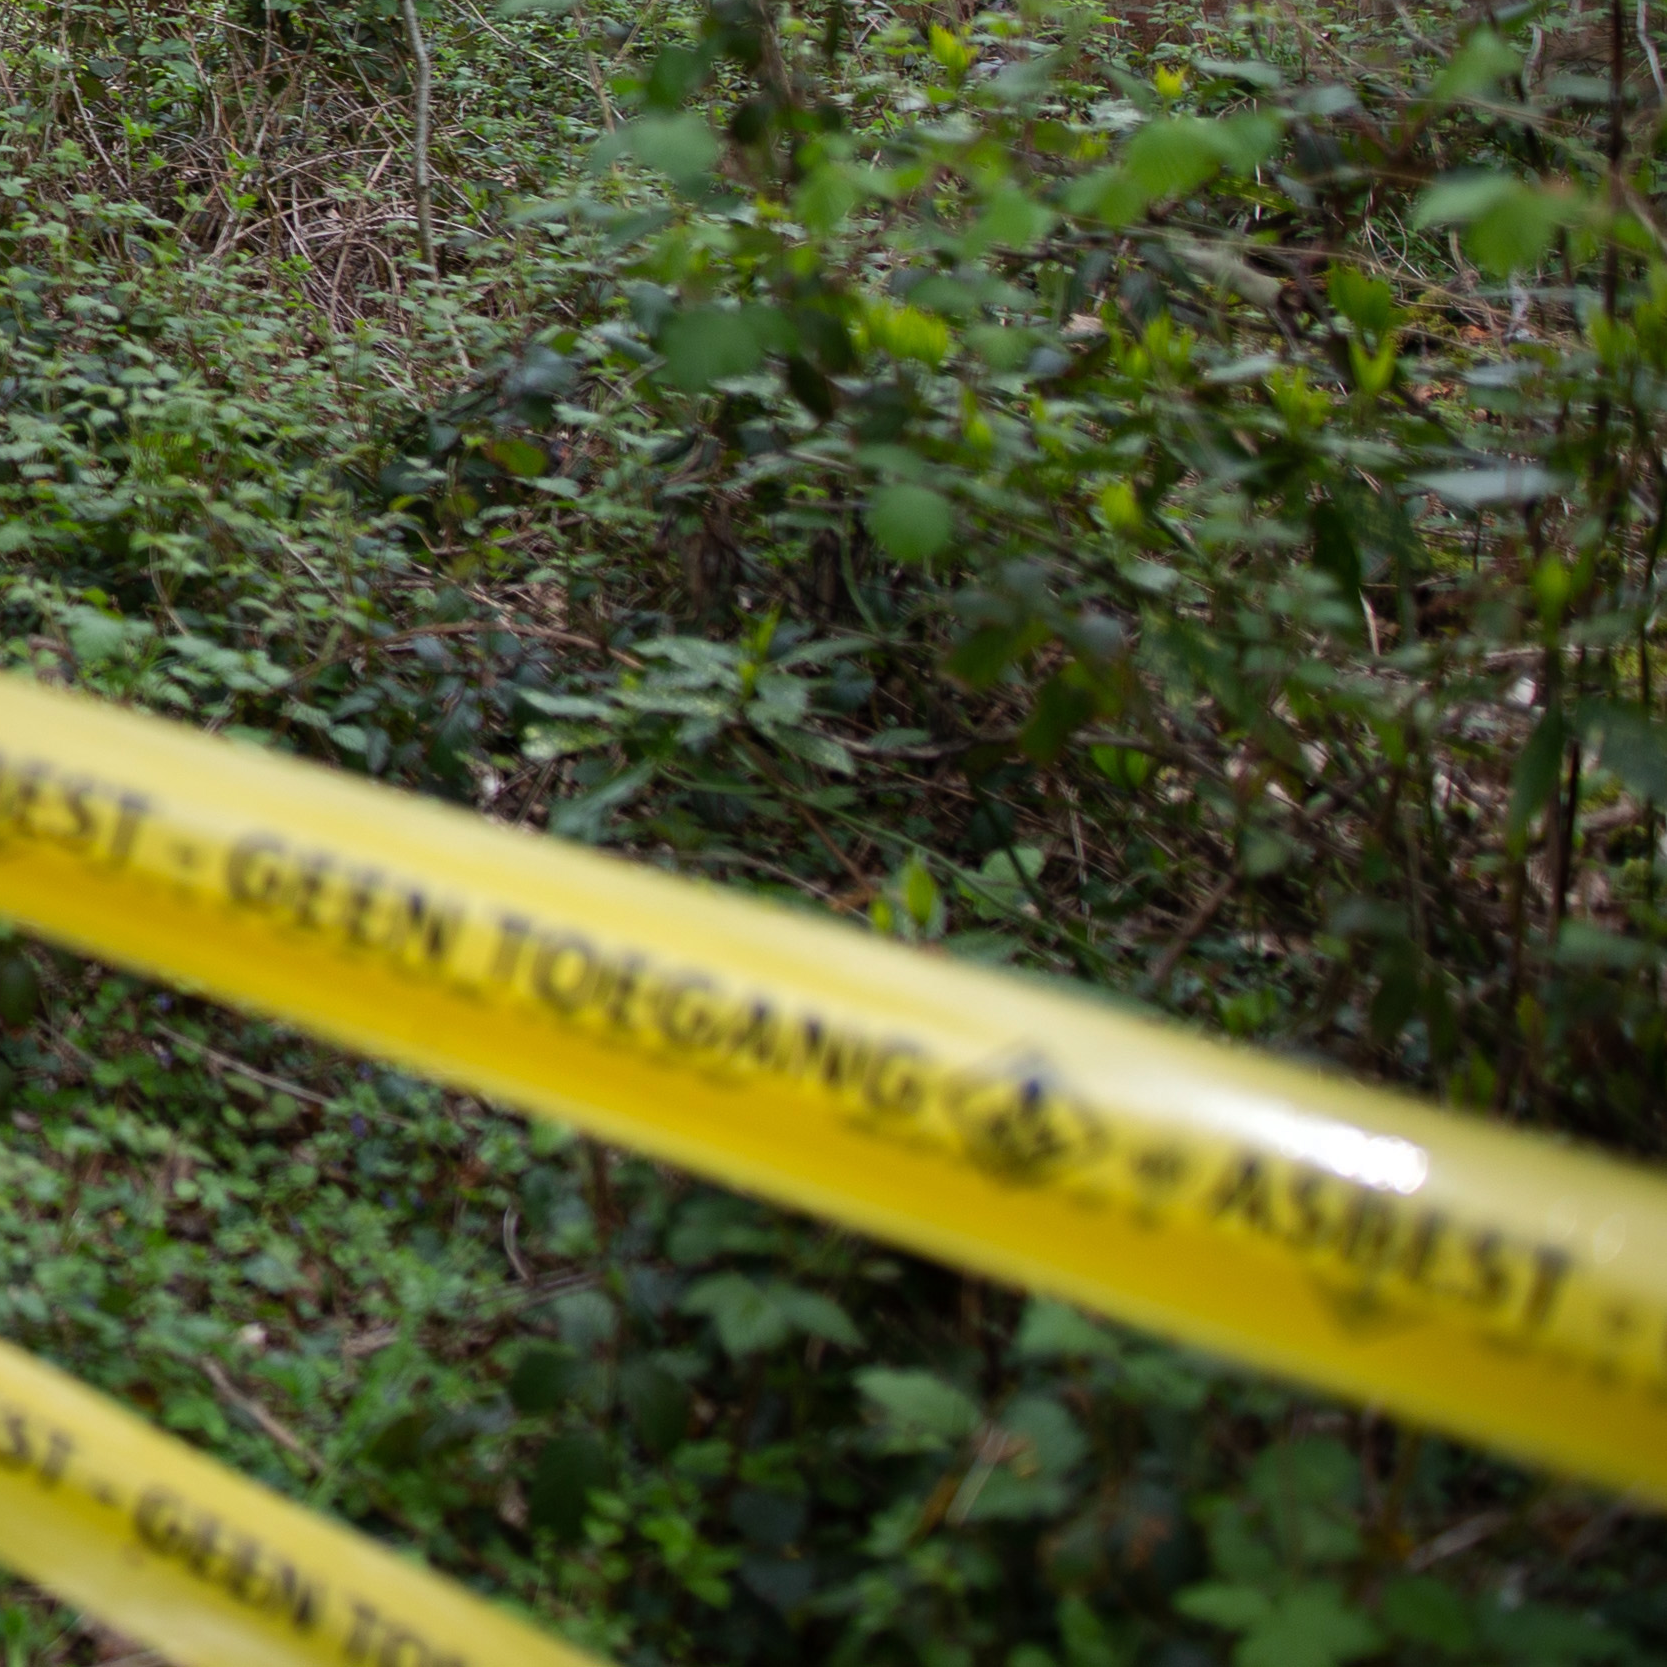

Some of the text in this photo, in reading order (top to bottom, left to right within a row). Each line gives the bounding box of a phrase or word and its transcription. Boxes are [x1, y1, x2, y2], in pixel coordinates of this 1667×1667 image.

[222, 828, 463, 967] GEEN
[486, 914, 925, 1120] TOEGANG
[131, 1483, 325, 1630] GEEN
